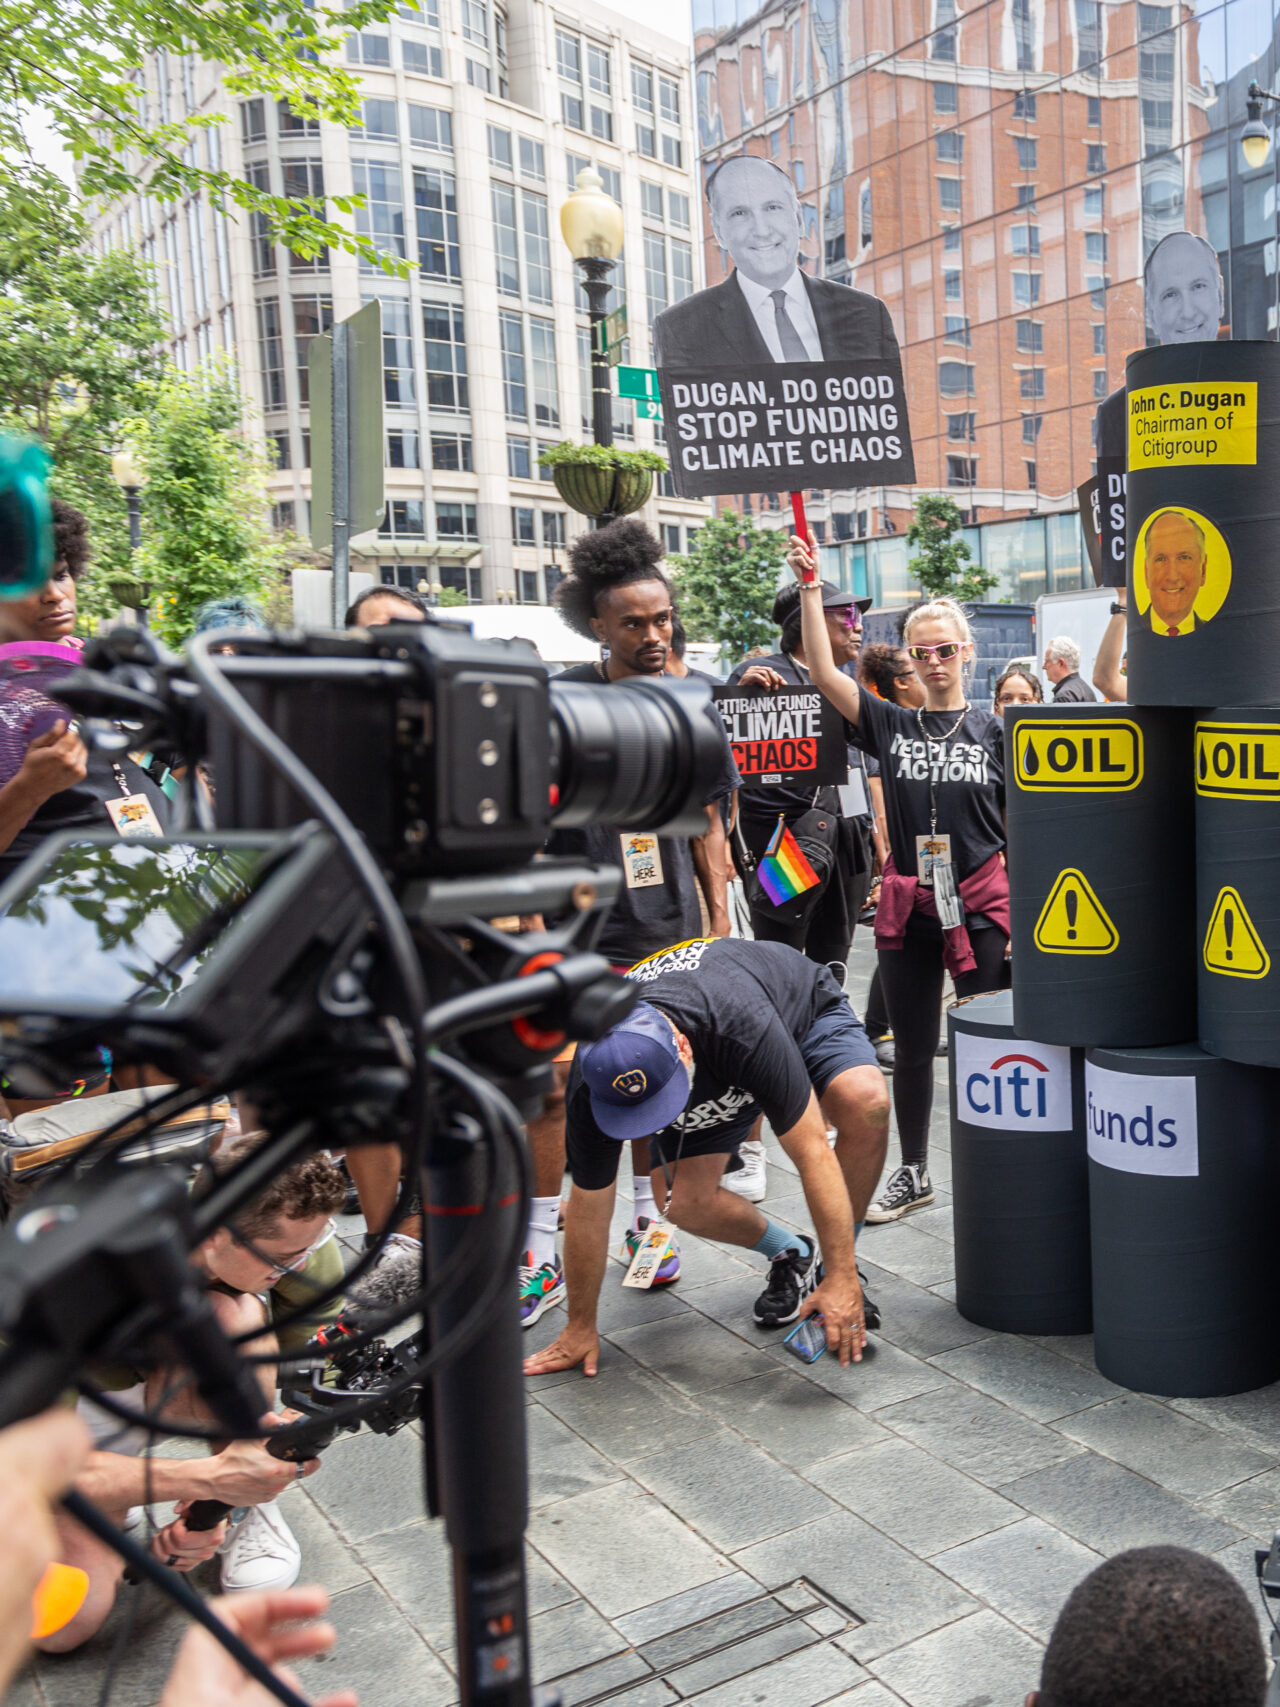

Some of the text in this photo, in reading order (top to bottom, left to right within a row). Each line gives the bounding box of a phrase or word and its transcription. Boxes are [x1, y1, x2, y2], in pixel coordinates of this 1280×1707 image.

[672, 375, 895, 408] DUGAN, DO GOOD
[1131, 390, 1246, 416] John C. Dugan
[677, 404, 899, 441] STOP FUNDING
[1136, 412, 1234, 436] Chairman of
[681, 435, 902, 471] CLIMATE CHAOS
[1142, 438, 1218, 459] Citigroup
[716, 694, 822, 715] CITIBANK FUNDS
[721, 709, 822, 742] CLIMATE
[890, 733, 984, 763] PEOPLE'S
[1047, 737, 1126, 773] OIL
[1213, 741, 1279, 780] OIL
[966, 1065, 1048, 1119] citi
[1088, 1090, 1178, 1149] funds
